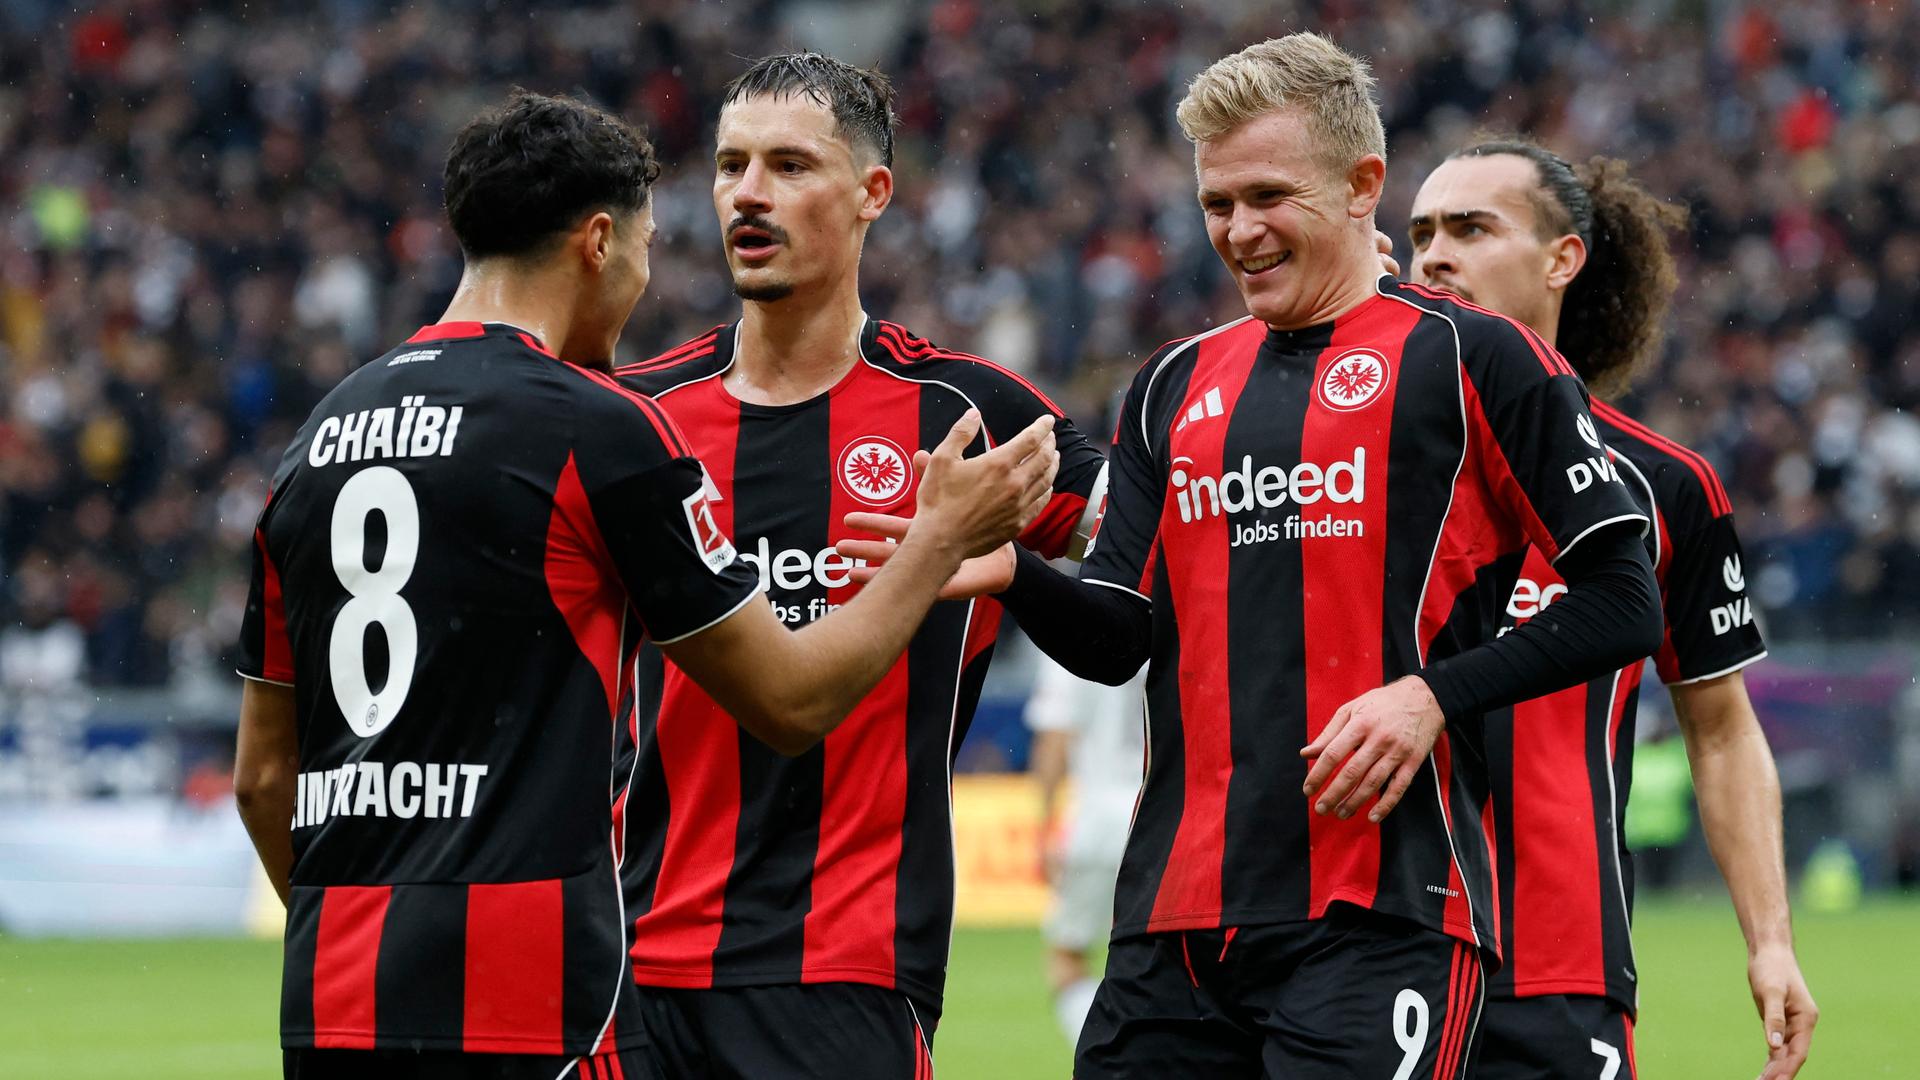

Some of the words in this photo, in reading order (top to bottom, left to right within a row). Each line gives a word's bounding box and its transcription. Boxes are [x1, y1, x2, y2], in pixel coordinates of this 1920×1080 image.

[308, 395, 464, 468] CHAÏBI
[1171, 446, 1366, 524] indeed
[1231, 520, 1279, 547] Jobs
[1283, 513, 1364, 540] finden
[737, 536, 897, 593] dee
[329, 465, 420, 738] 8
[771, 600, 802, 623] bs
[1710, 596, 1753, 636] DVA
[1426, 884, 1459, 898] AEROREADY
[1392, 988, 1430, 1080] 9
[1591, 1037, 1622, 1080] 7
